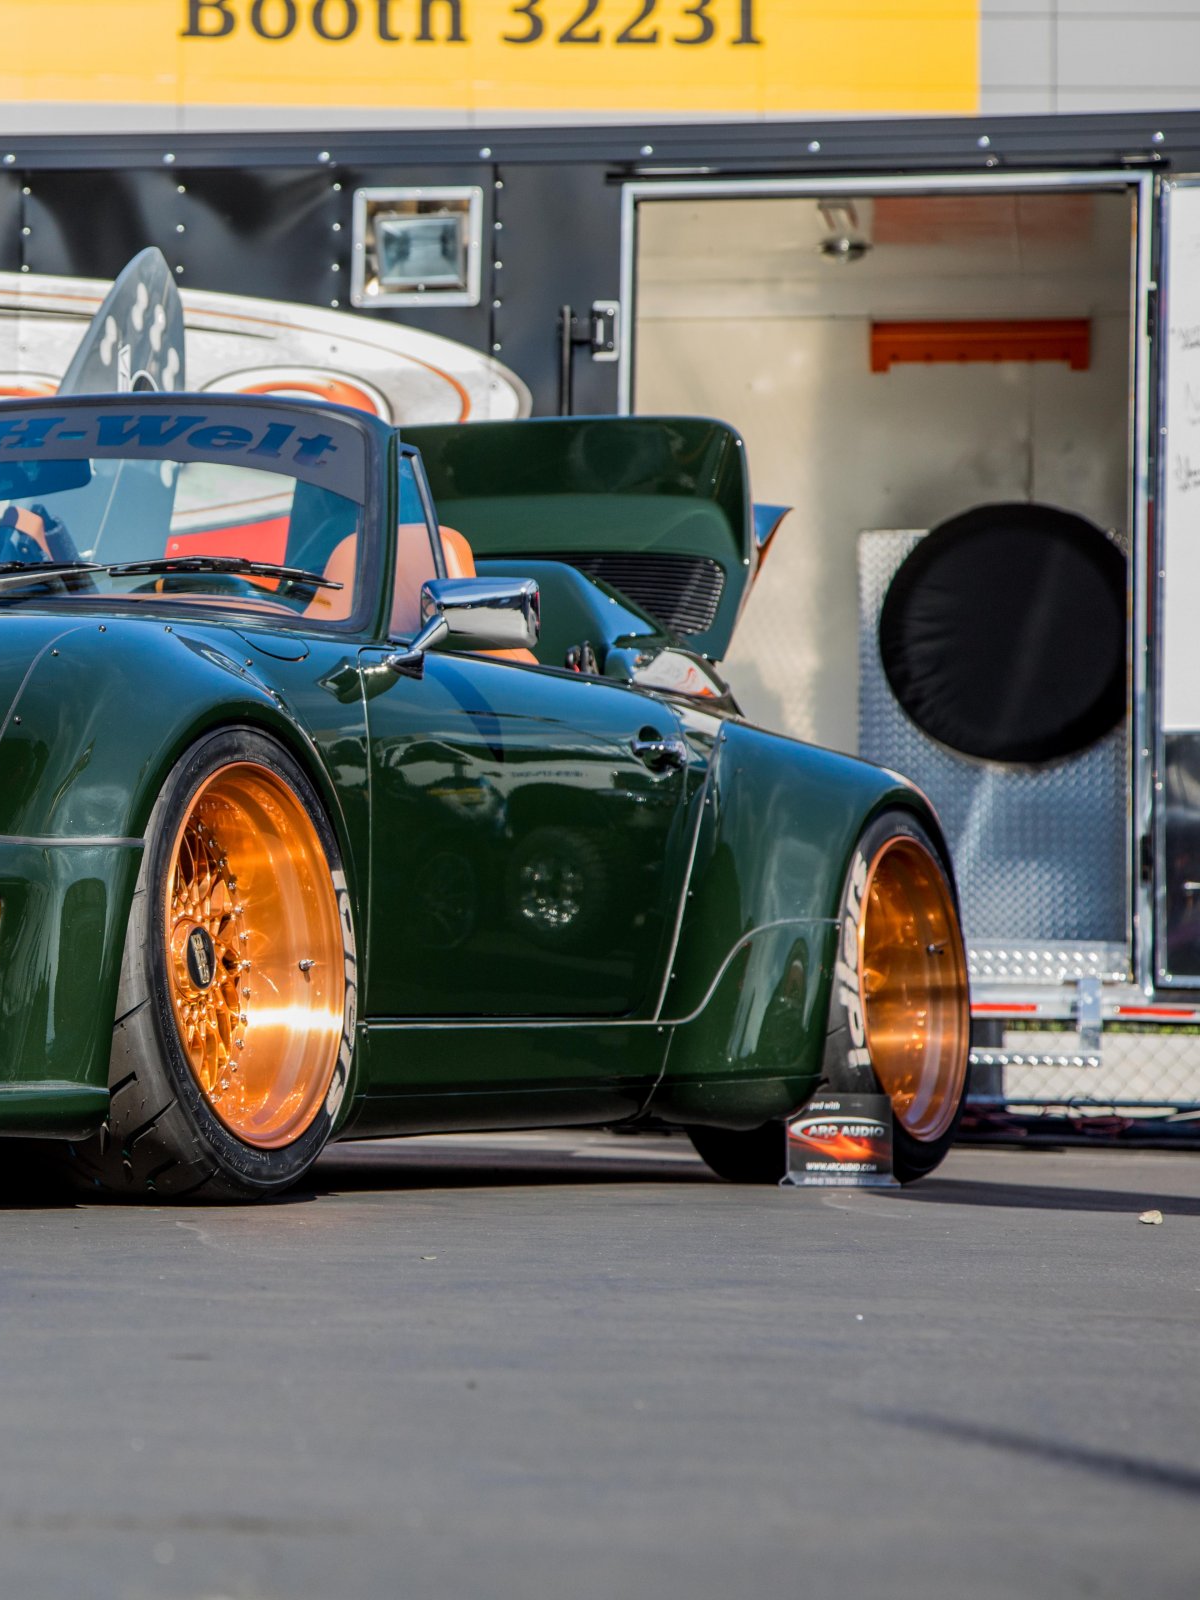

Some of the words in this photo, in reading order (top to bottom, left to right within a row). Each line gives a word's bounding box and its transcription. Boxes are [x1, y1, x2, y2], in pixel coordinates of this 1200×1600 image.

[179, 0, 468, 42] Booth
[808, 1125, 838, 1136] ARC
[841, 1125, 884, 1136] AUDIO
